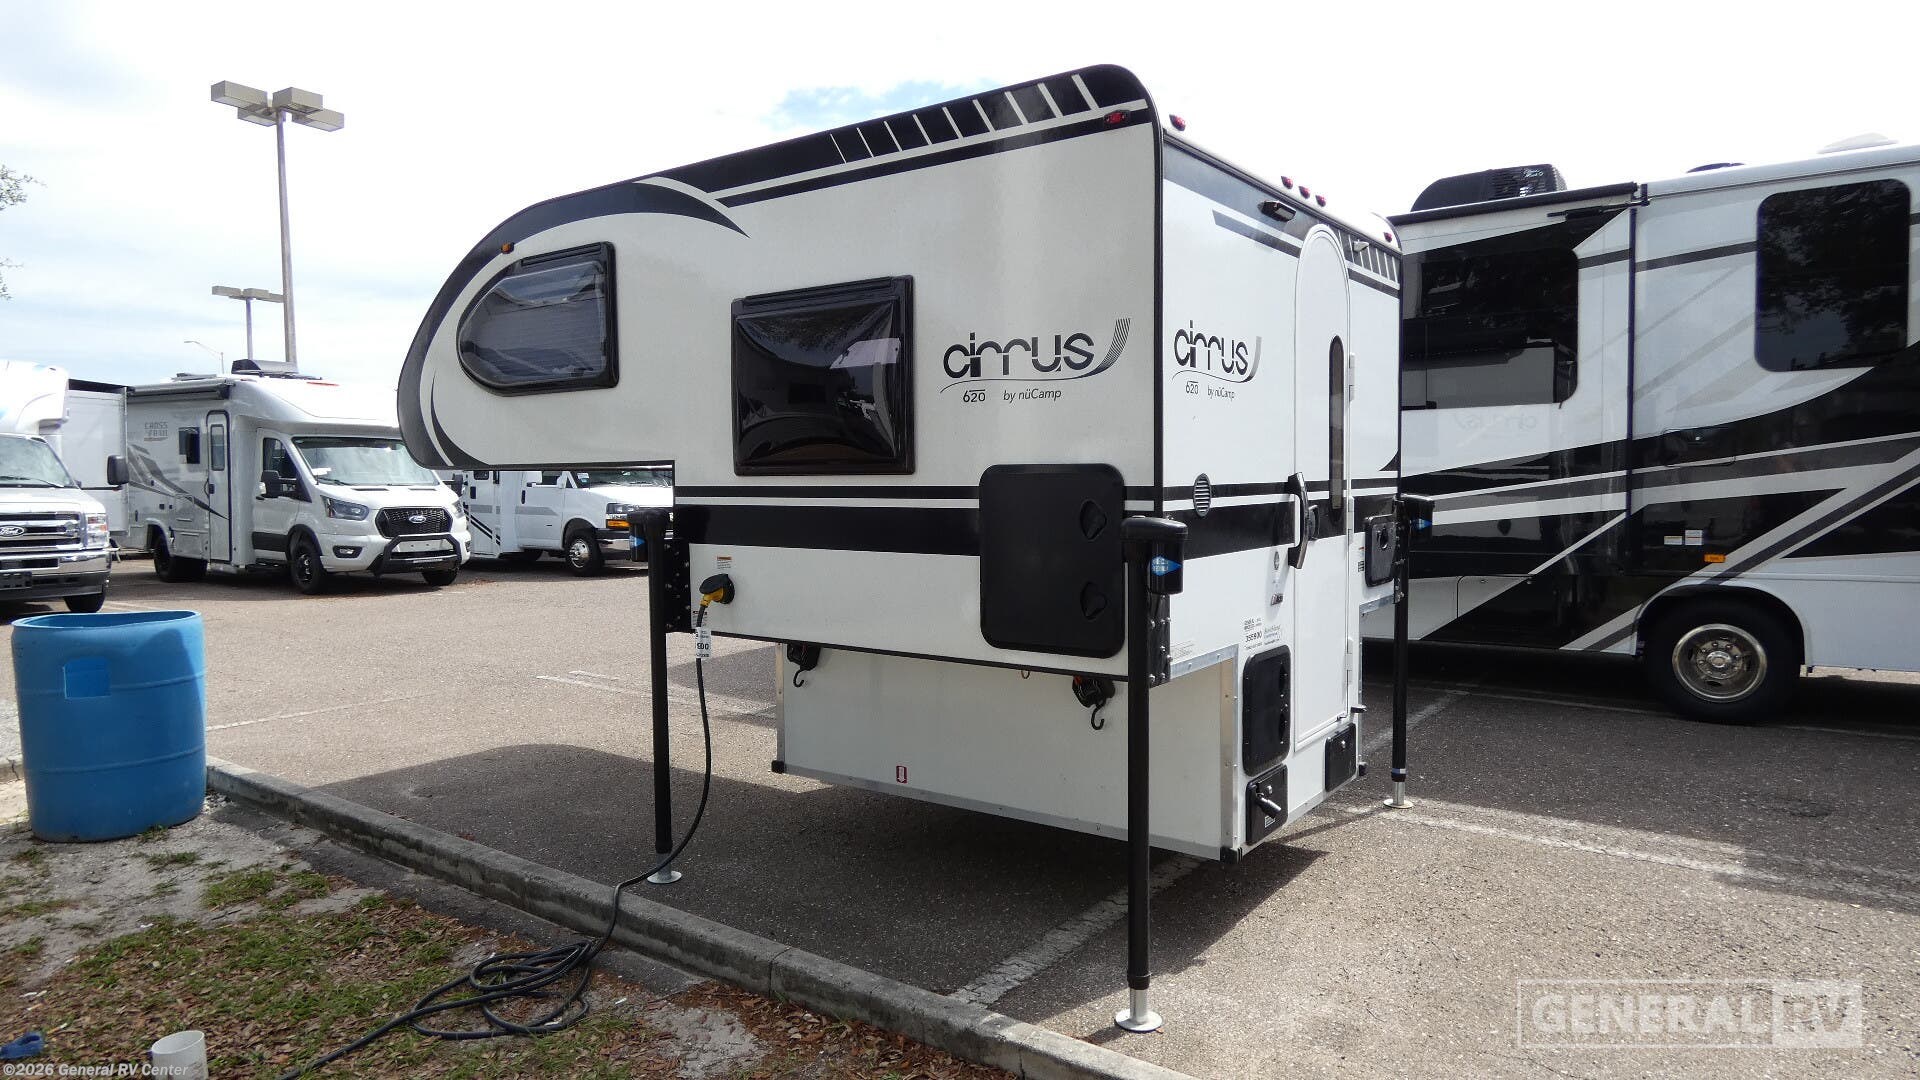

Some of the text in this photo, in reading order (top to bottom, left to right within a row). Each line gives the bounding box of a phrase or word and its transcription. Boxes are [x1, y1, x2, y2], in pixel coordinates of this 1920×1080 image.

[1174, 320, 1248, 375] cirrus
[943, 332, 1094, 378] cirrus
[1186, 381, 1198, 394] 620
[963, 389, 986, 402] 620
[1003, 388, 1062, 402] by nüCamp
